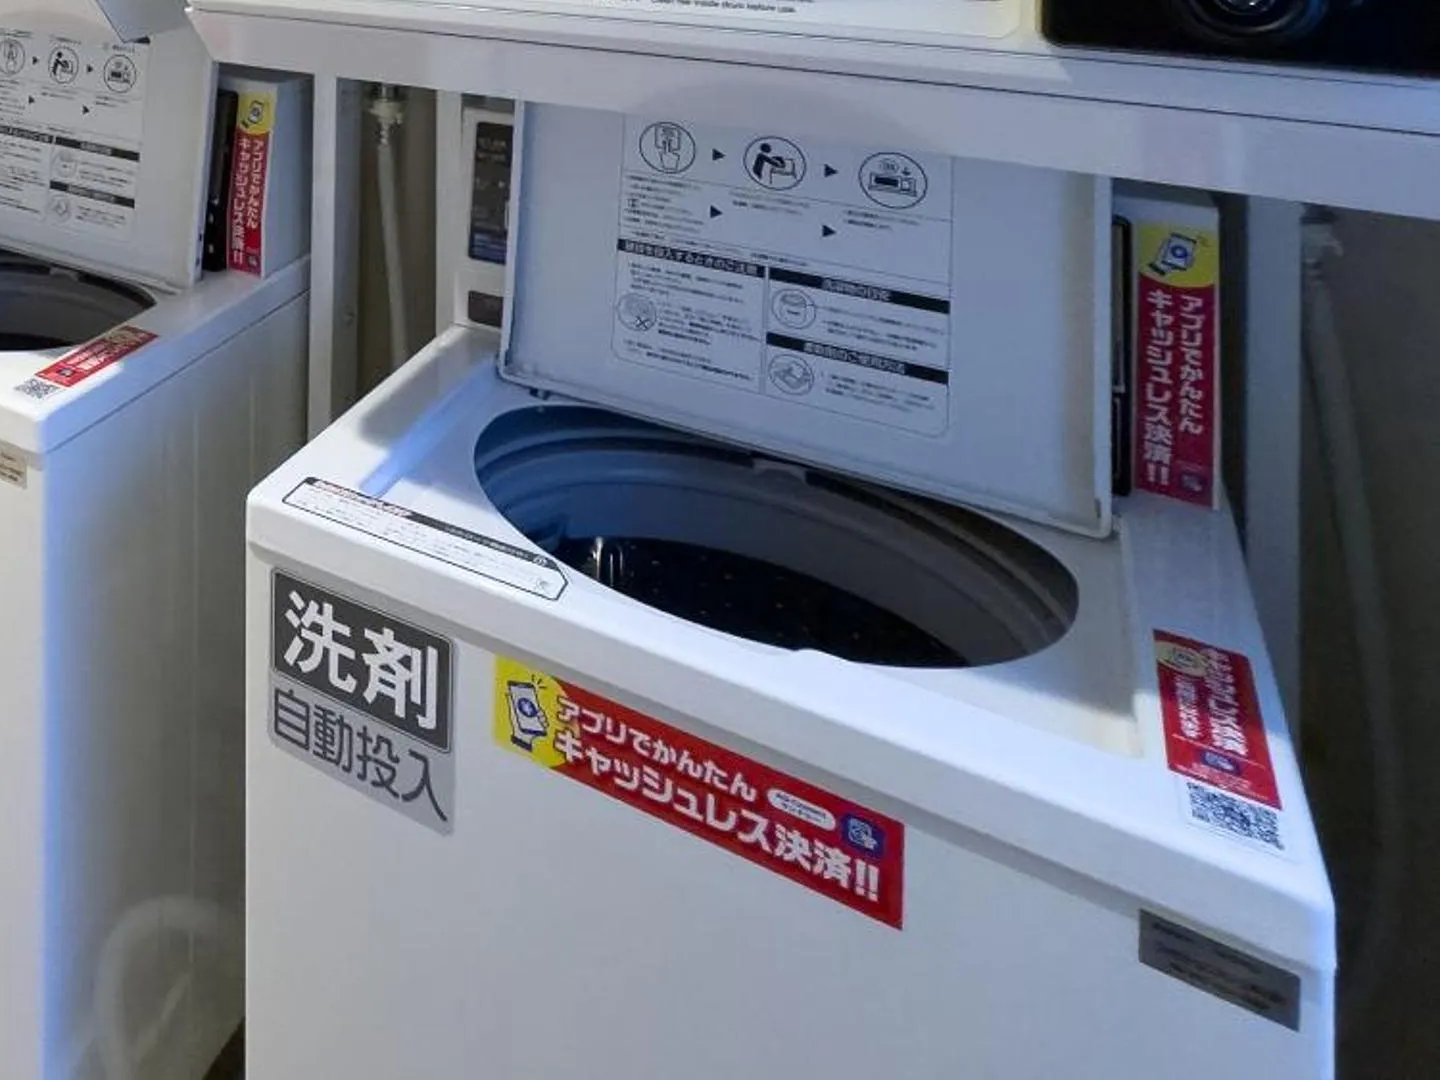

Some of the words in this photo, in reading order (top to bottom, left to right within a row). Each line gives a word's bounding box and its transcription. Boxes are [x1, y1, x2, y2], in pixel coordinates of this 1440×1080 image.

[283, 589, 440, 732] 洗剤
[274, 689, 449, 823] 自動投入
[553, 730, 881, 903] キャッシュレス決済!!
[555, 695, 758, 803] アプリでかんたん
